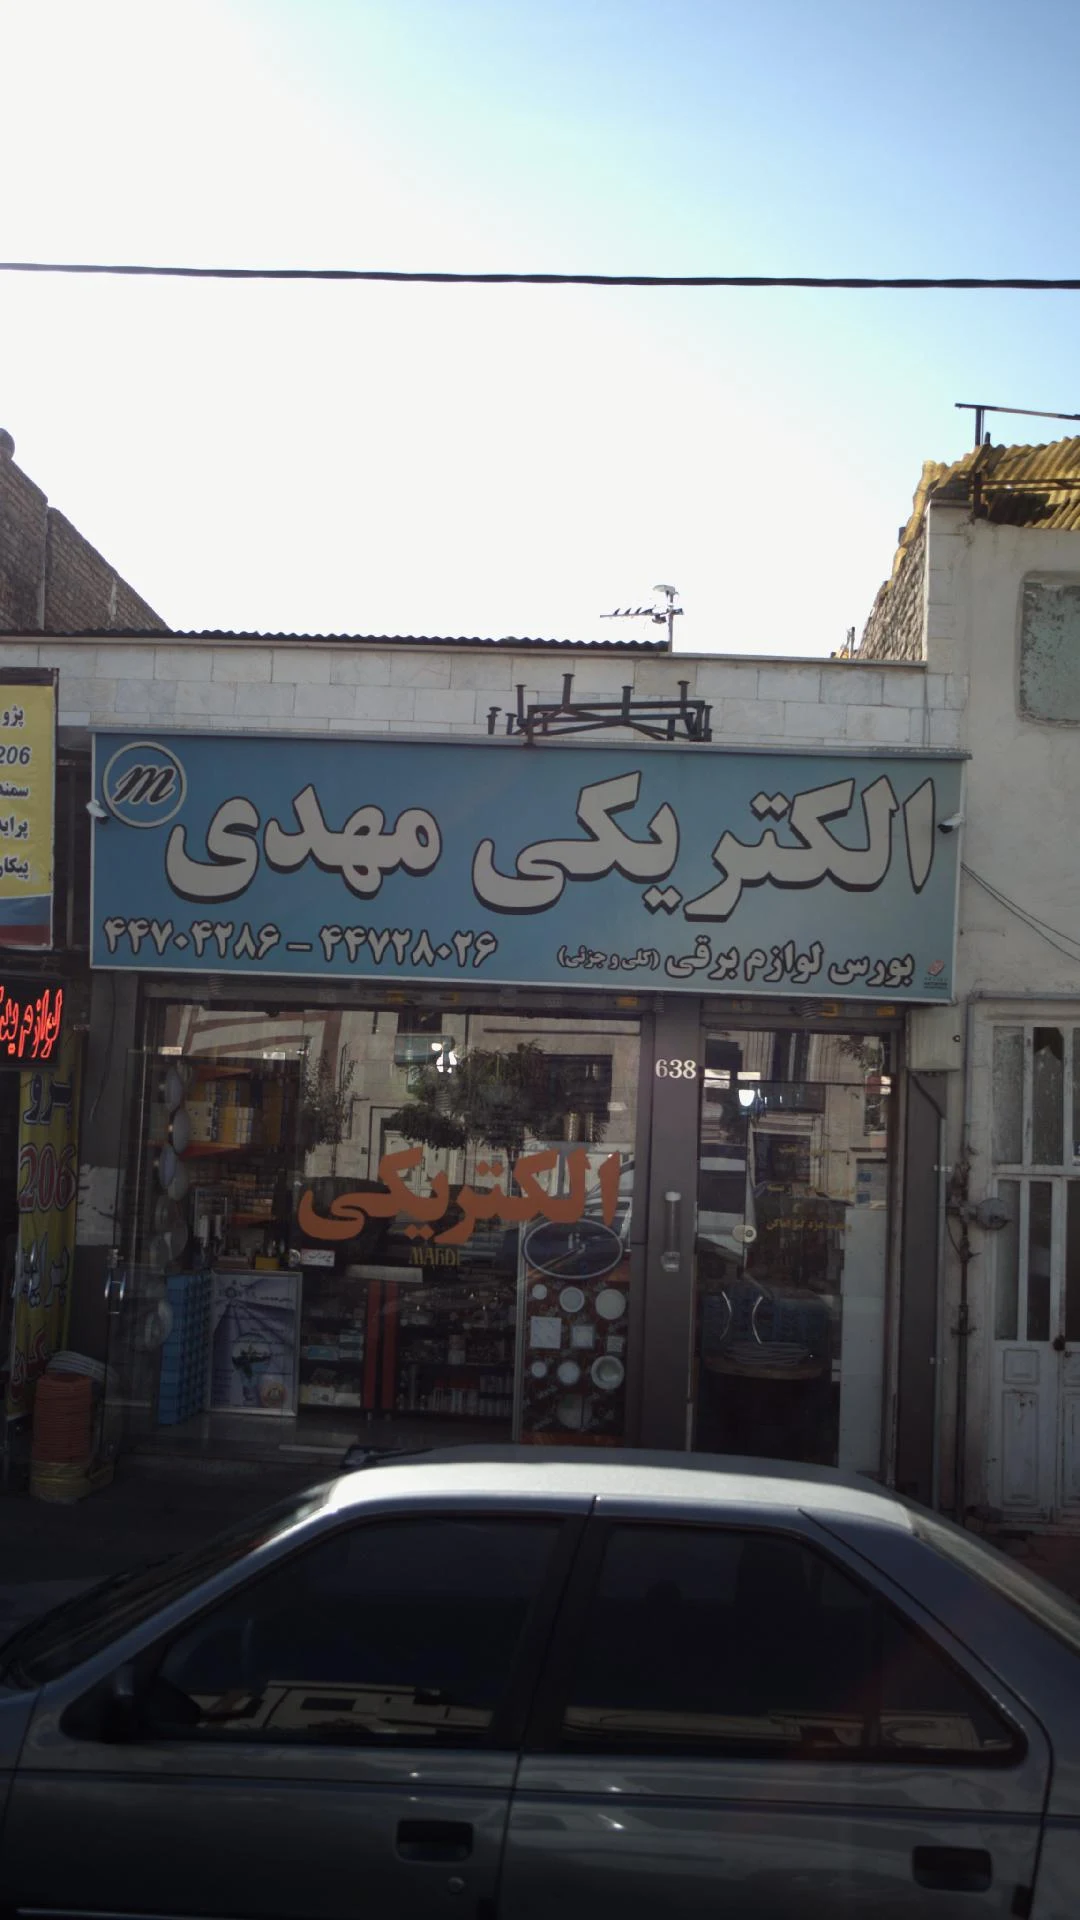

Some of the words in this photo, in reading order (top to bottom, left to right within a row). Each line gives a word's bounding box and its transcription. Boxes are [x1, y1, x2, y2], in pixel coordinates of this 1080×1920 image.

[2, 704, 24, 727] پژو
[0, 745, 31, 765] 206
[165, 784, 442, 904] مهدی
[471, 770, 935, 922] الکتریکی
[103, 916, 281, 960] ۴۴۷۰۴۲۸۶
[319, 924, 498, 967] ۴۴۷۲۸۰۲۶
[664, 934, 740, 979] برقی
[744, 939, 824, 984] لوازم
[828, 953, 915, 988] بورس
[18, 987, 64, 1059] لوازم
[655, 1058, 697, 1080] 638
[18, 1143, 77, 1213] 206
[298, 1147, 621, 1245] الکتریکی
